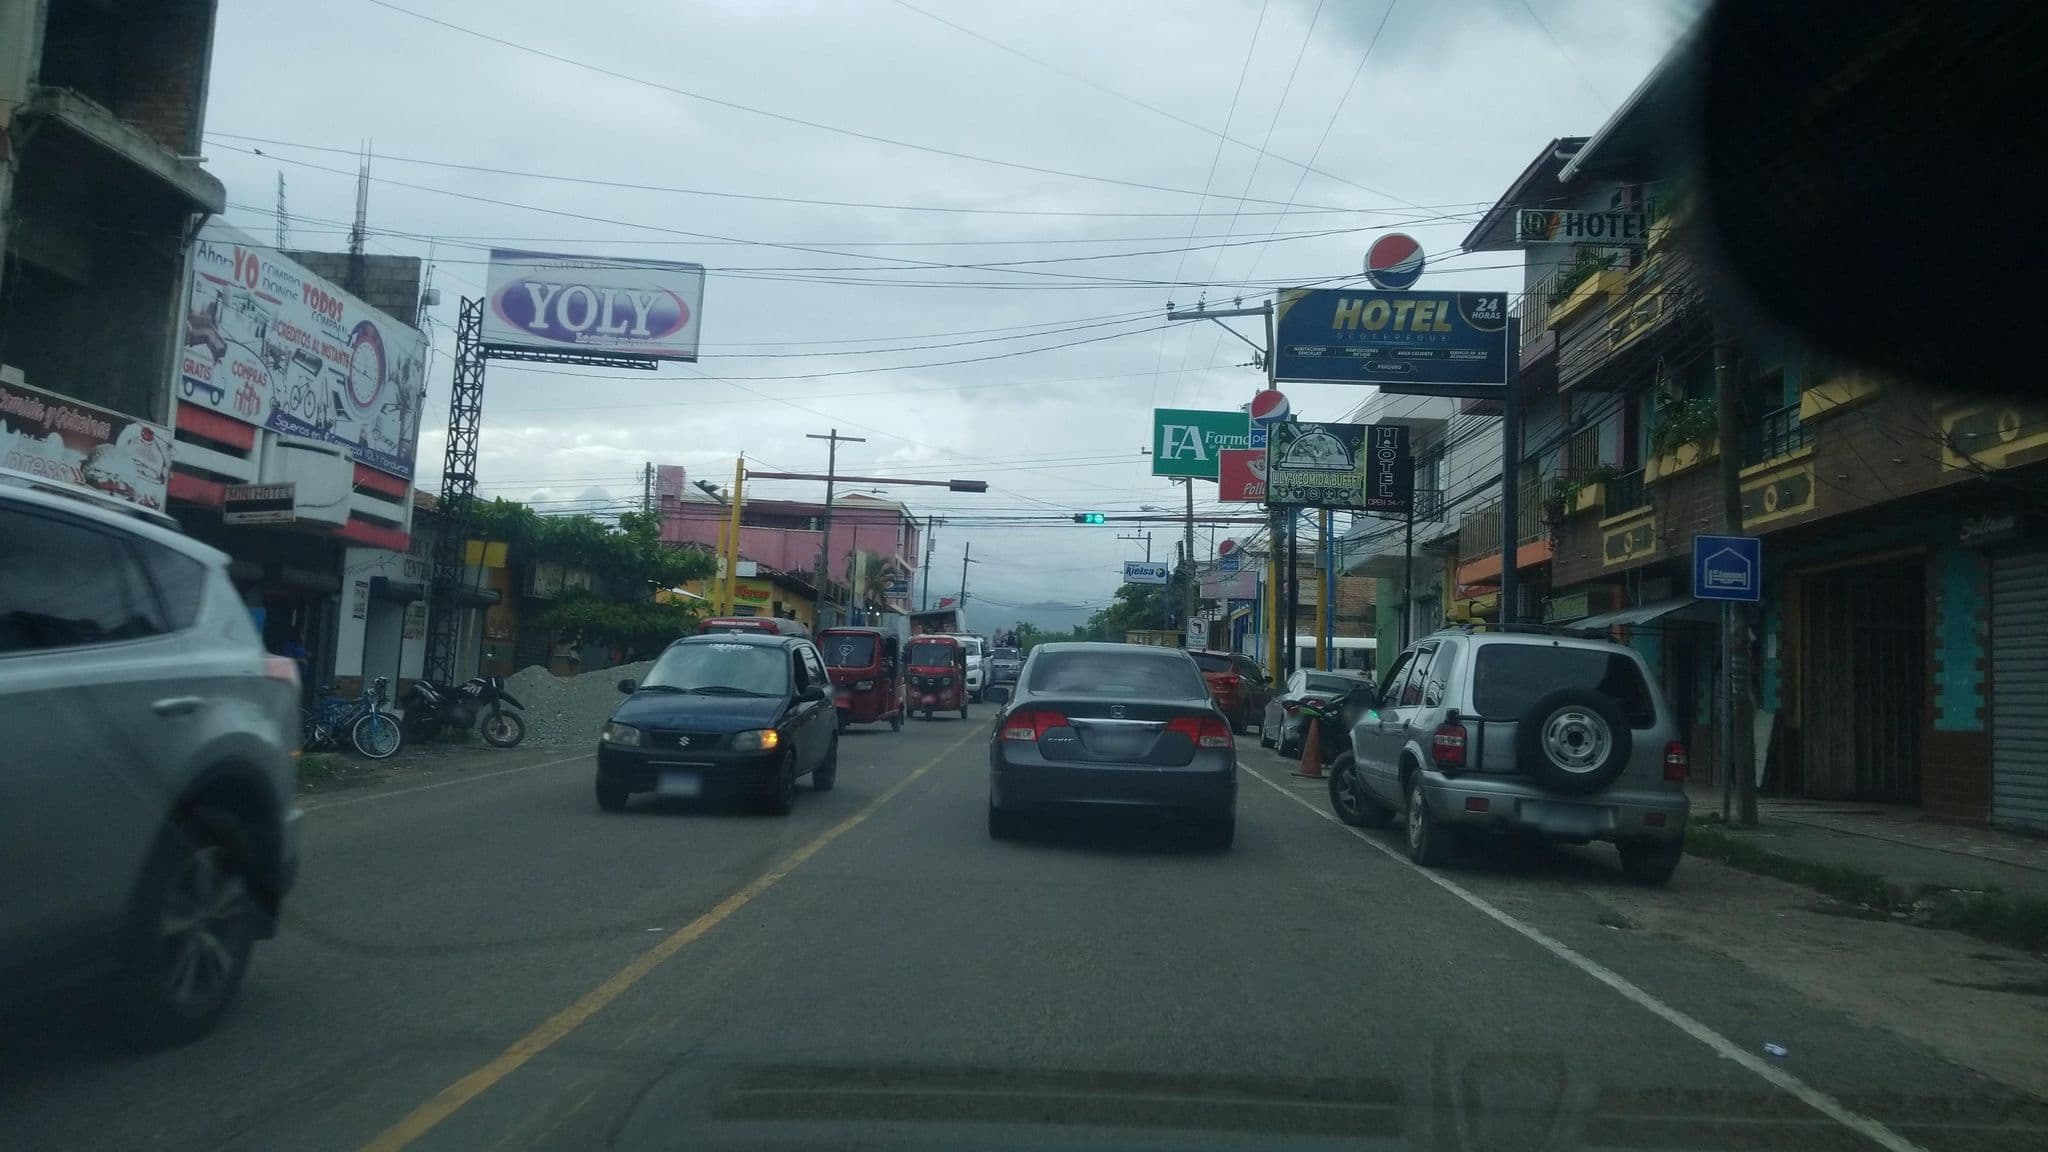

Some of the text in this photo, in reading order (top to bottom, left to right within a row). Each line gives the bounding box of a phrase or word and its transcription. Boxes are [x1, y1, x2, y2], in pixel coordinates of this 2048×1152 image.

[234, 245, 259, 289] YO
[302, 281, 344, 321] TODOS
[524, 282, 660, 337] YOLY
[1332, 298, 1452, 333] HOTEL
[1471, 311, 1501, 320] HORAS
[1475, 298, 1499, 312] 24
[183, 358, 211, 381] GRATIS
[231, 361, 267, 387] COMPRAS
[1160, 424, 1208, 461] FA
[1375, 426, 1399, 498] HOTEL
[1332, 474, 1362, 489] BUFFET
